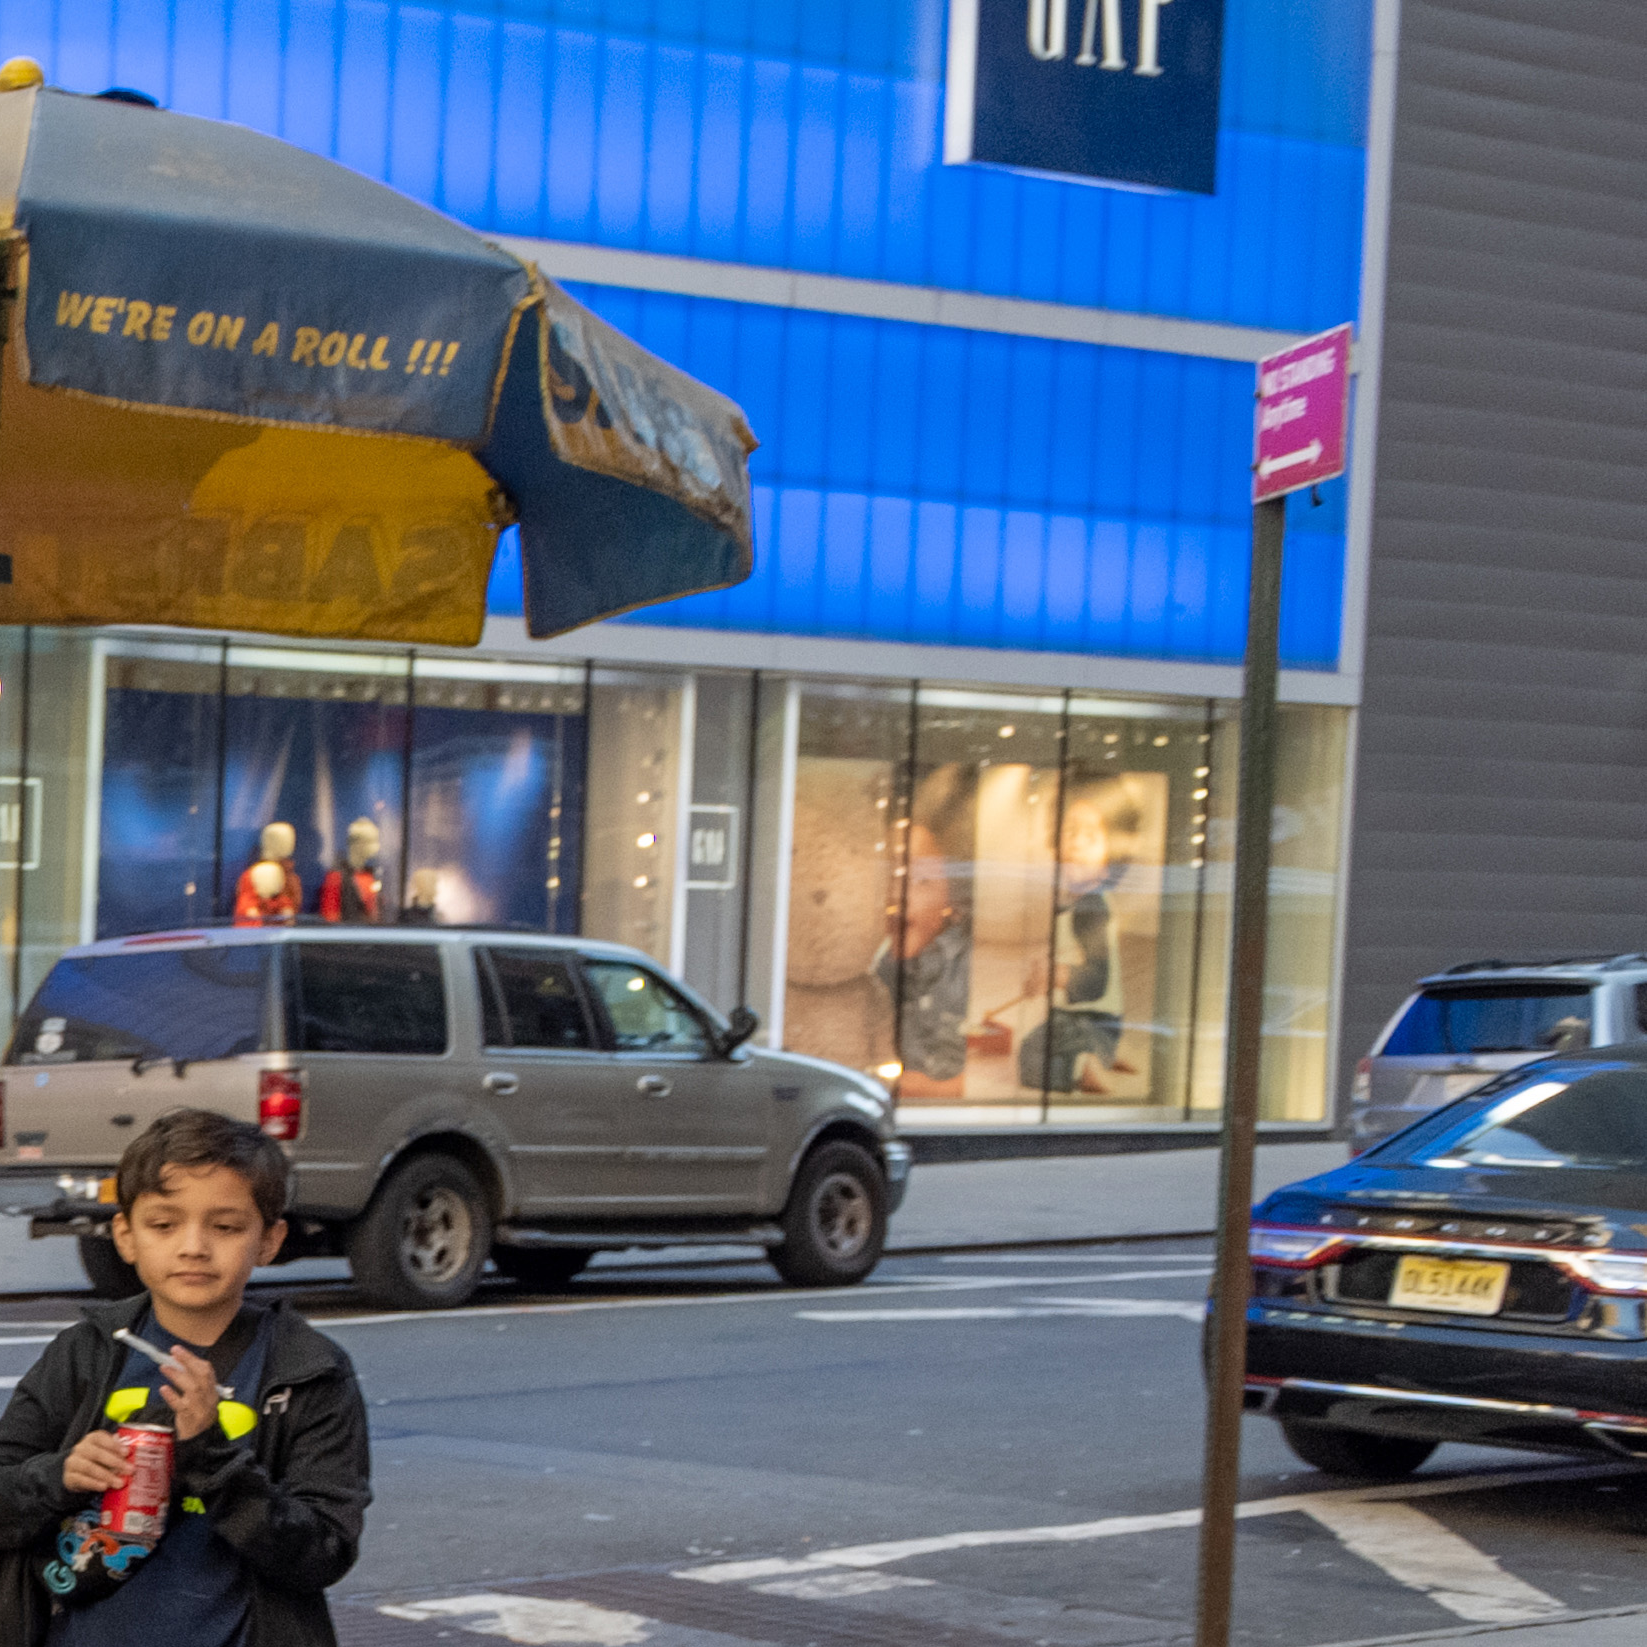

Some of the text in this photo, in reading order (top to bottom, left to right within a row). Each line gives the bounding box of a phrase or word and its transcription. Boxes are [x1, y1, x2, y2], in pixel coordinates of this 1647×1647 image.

[56, 290, 177, 342] WE'RE
[188, 309, 241, 353] ON
[252, 320, 279, 356] A
[293, 326, 391, 373] ROLL
